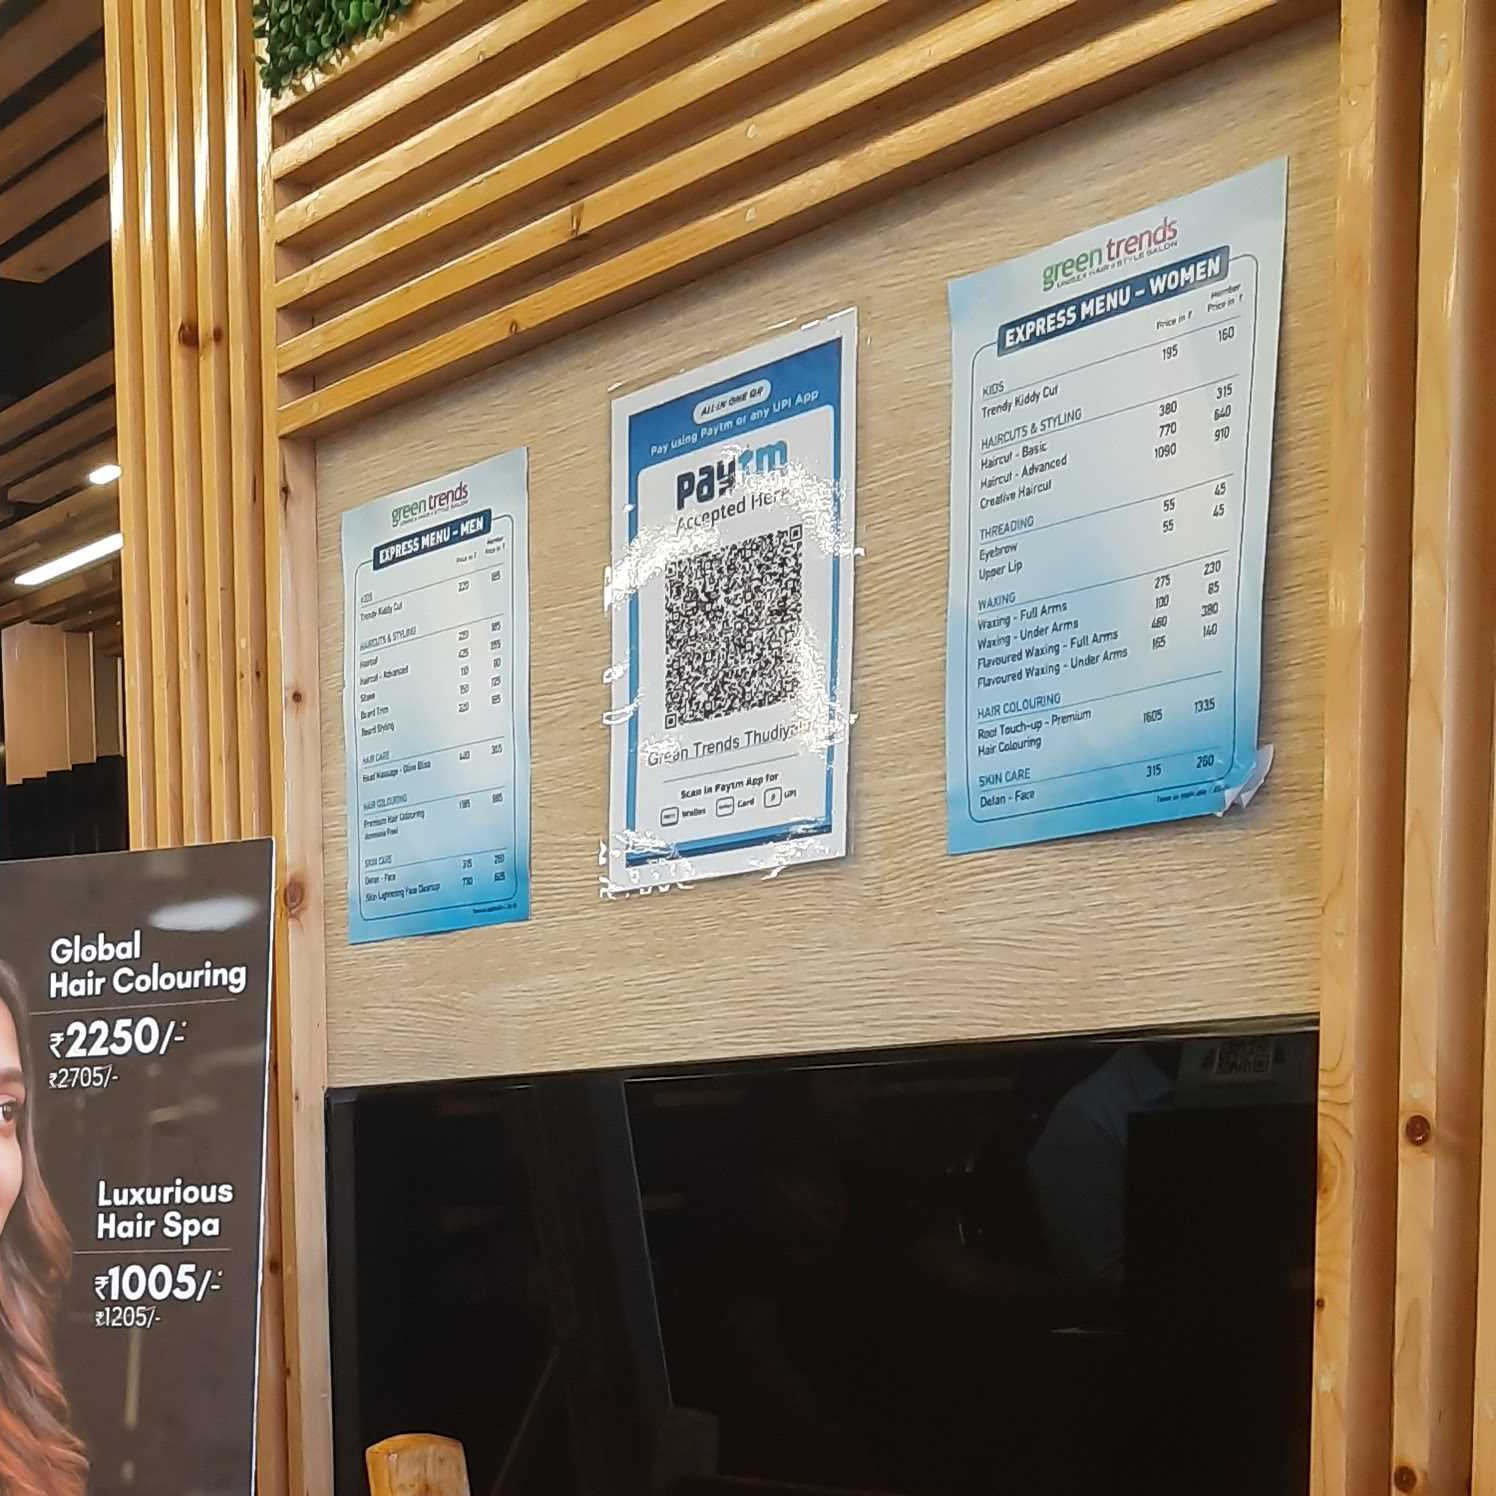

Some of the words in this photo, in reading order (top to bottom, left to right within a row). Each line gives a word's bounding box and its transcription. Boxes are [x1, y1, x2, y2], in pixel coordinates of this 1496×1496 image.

[1043, 247, 1102, 291] green
[1106, 216, 1177, 258] trends
[1005, 307, 1076, 345] EXPRESS
[1080, 287, 1130, 321] MENU
[1149, 256, 1220, 292] WOMEN
[982, 398, 1012, 421] Trendy
[1014, 388, 1040, 410] Kiddy
[1043, 382, 1058, 399] Cut
[1162, 343, 1178, 361] 195
[1218, 325, 1234, 343] 160
[982, 381, 1004, 398] KIDS
[651, 443, 668, 457] Pay
[671, 431, 698, 449] using
[701, 419, 733, 438] Paytm
[736, 415, 747, 425] or
[750, 407, 770, 421] any
[773, 398, 792, 412] UPI
[795, 390, 819, 406] App
[981, 450, 1011, 471] Haircut
[1021, 440, 1047, 458] Basic
[1158, 400, 1177, 418] 380
[1216, 383, 1232, 400] 315
[981, 424, 1027, 450] HAIRCUTS
[1030, 421, 1037, 434] &
[1039, 407, 1081, 432] STYLING
[980, 488, 1015, 510] Creative
[1018, 478, 1051, 498] Haircut
[1154, 442, 1176, 460] 1090
[1214, 426, 1229, 442] 910
[981, 470, 1012, 490] Haircut
[1021, 454, 1066, 478] Advanced
[1159, 421, 1176, 438] 770
[392, 499, 426, 527] green
[429, 482, 468, 510] trends
[676, 496, 746, 534] Accepted
[379, 539, 419, 563] EXPRESS
[421, 528, 449, 548] MENU
[460, 516, 483, 534] MEN
[978, 563, 1005, 584] Upper
[1007, 558, 1022, 576] Lip
[1162, 518, 1173, 533] 55
[1212, 504, 1224, 519] 45
[979, 541, 1017, 564] Eyebrow
[1163, 497, 1175, 513] 55
[980, 514, 1033, 540] THREADING
[977, 632, 1010, 652] Waxing
[1020, 623, 1049, 640] Under
[1051, 617, 1078, 634] Arms
[1208, 581, 1219, 595] 85
[978, 613, 1010, 633] Waxing
[1020, 606, 1038, 621] Full
[1039, 599, 1067, 617] Arms
[1154, 573, 1170, 589] 275
[1203, 560, 1221, 576] 230
[978, 591, 1015, 610] WAXING
[977, 649, 1022, 670] Flavoured
[1025, 641, 1060, 661] Waxing
[1070, 635, 1089, 650] Full
[1091, 628, 1118, 645] Arms
[977, 668, 1022, 689] Flavoured
[1025, 661, 1060, 681] Waxing
[1070, 652, 1100, 669] Under
[1102, 646, 1127, 662] Arms
[977, 704, 999, 719] HAIR
[1003, 692, 1060, 714] COLOURING
[978, 743, 996, 757] Hair
[998, 735, 1041, 756] Colouring
[1194, 697, 1215, 713] 1335
[999, 717, 1042, 738] Touch-up
[1051, 708, 1091, 726] Premium
[693, 735, 740, 759] Trends
[681, 788, 702, 799] Scan
[715, 780, 744, 793] Paytm
[746, 777, 764, 786] App
[766, 773, 779, 781] for
[979, 773, 1002, 787] SKIN
[1005, 767, 1030, 782] CARE
[980, 793, 1005, 808] Detan
[1015, 788, 1034, 802] Face
[1146, 764, 1161, 777] 315
[50, 930, 142, 965] Global
[50, 970, 106, 998] Hair
[112, 961, 247, 994] Colouring
[97, 1179, 234, 1207] Luxurious
[96, 1213, 155, 1240] Hair
[162, 1212, 221, 1246] Spa
